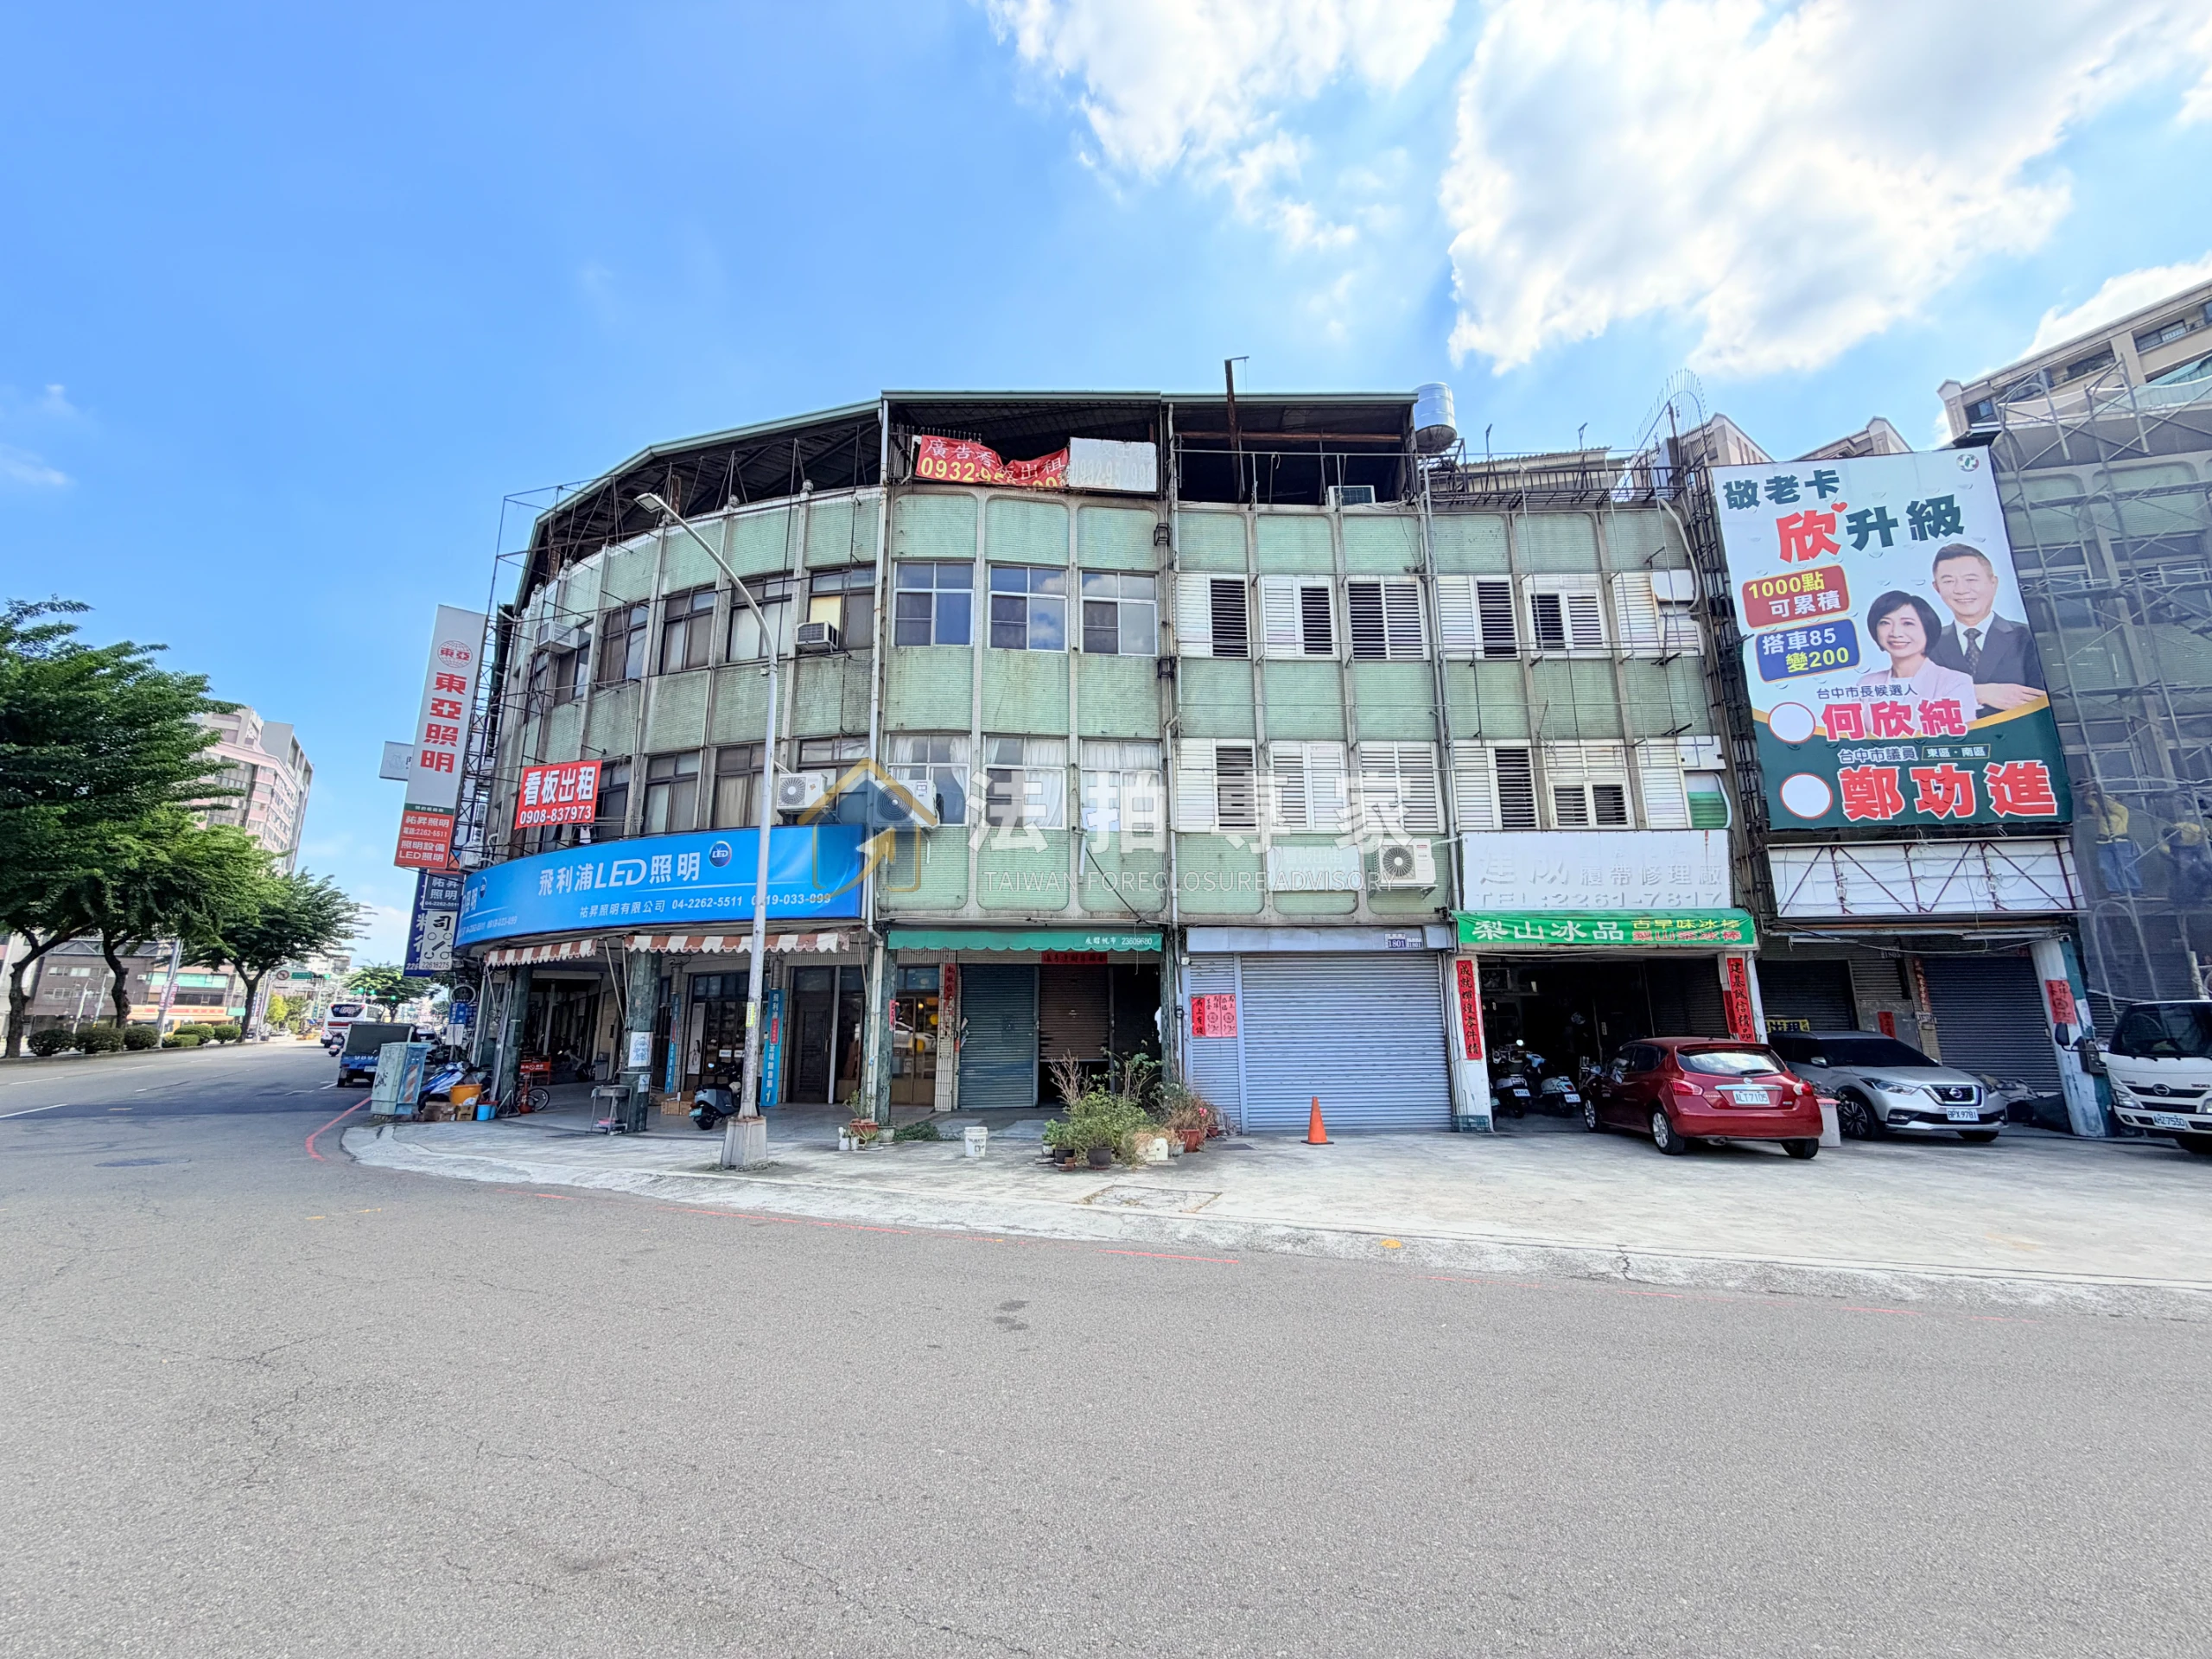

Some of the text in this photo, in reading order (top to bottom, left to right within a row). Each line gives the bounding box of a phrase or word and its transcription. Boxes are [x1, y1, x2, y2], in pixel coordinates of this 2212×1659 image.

[1723, 469, 1840, 511] 敬老卡
[1776, 494, 1965, 563] 欣升級
[1748, 573, 1825, 600] 1000點
[1769, 590, 1841, 619] 可累積
[1763, 627, 1836, 655] 搭車85
[440, 647, 470, 661] 東亞
[1786, 646, 1849, 673] 變200
[1816, 684, 1918, 700] 台中市長候選人
[420, 671, 467, 773] 東亞照明
[1821, 698, 1967, 742] 何欣純
[1838, 746, 1919, 763] 台中市議員
[524, 766, 596, 806] 看板出租
[1837, 761, 2058, 821] 鄭功進
[405, 816, 449, 828] 祐昇照明
[519, 805, 592, 825] 0908-837973
[398, 851, 444, 862] LED照明
[401, 840, 445, 852] 照明設備
[538, 852, 701, 896] 飛利浦LED照明
[430, 888, 458, 900] 照明
[580, 893, 831, 918] 祐昇照明有限公司 04-2262-5511 019-033-099
[1471, 920, 1624, 942] 梨山冰品
[1631, 919, 1740, 929] 古早味冰棒
[1389, 939, 1405, 948] 1801
